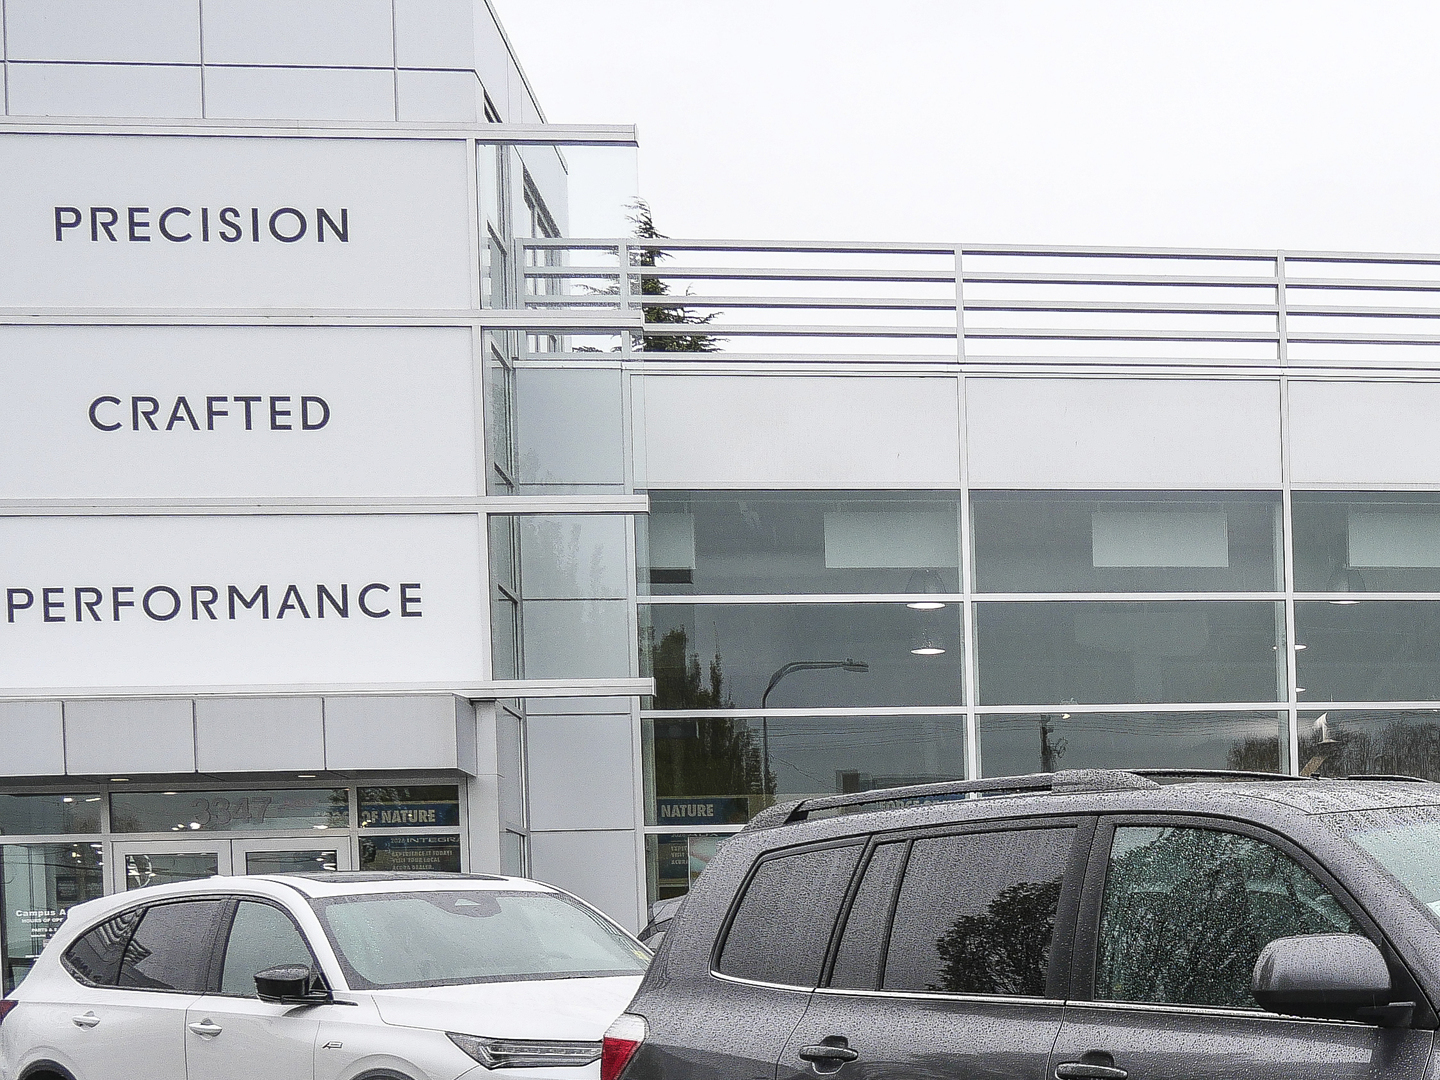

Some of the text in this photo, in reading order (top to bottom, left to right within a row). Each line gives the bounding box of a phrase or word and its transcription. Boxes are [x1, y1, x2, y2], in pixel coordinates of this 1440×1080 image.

[53, 206, 350, 243] PRECISION
[88, 396, 331, 431] CRAFTED
[6, 582, 423, 623] PERFORMANCE
[190, 797, 274, 826] 3347
[381, 809, 436, 824] NATURE
[661, 804, 714, 818] NATURE
[16, 909, 56, 917] Campus
